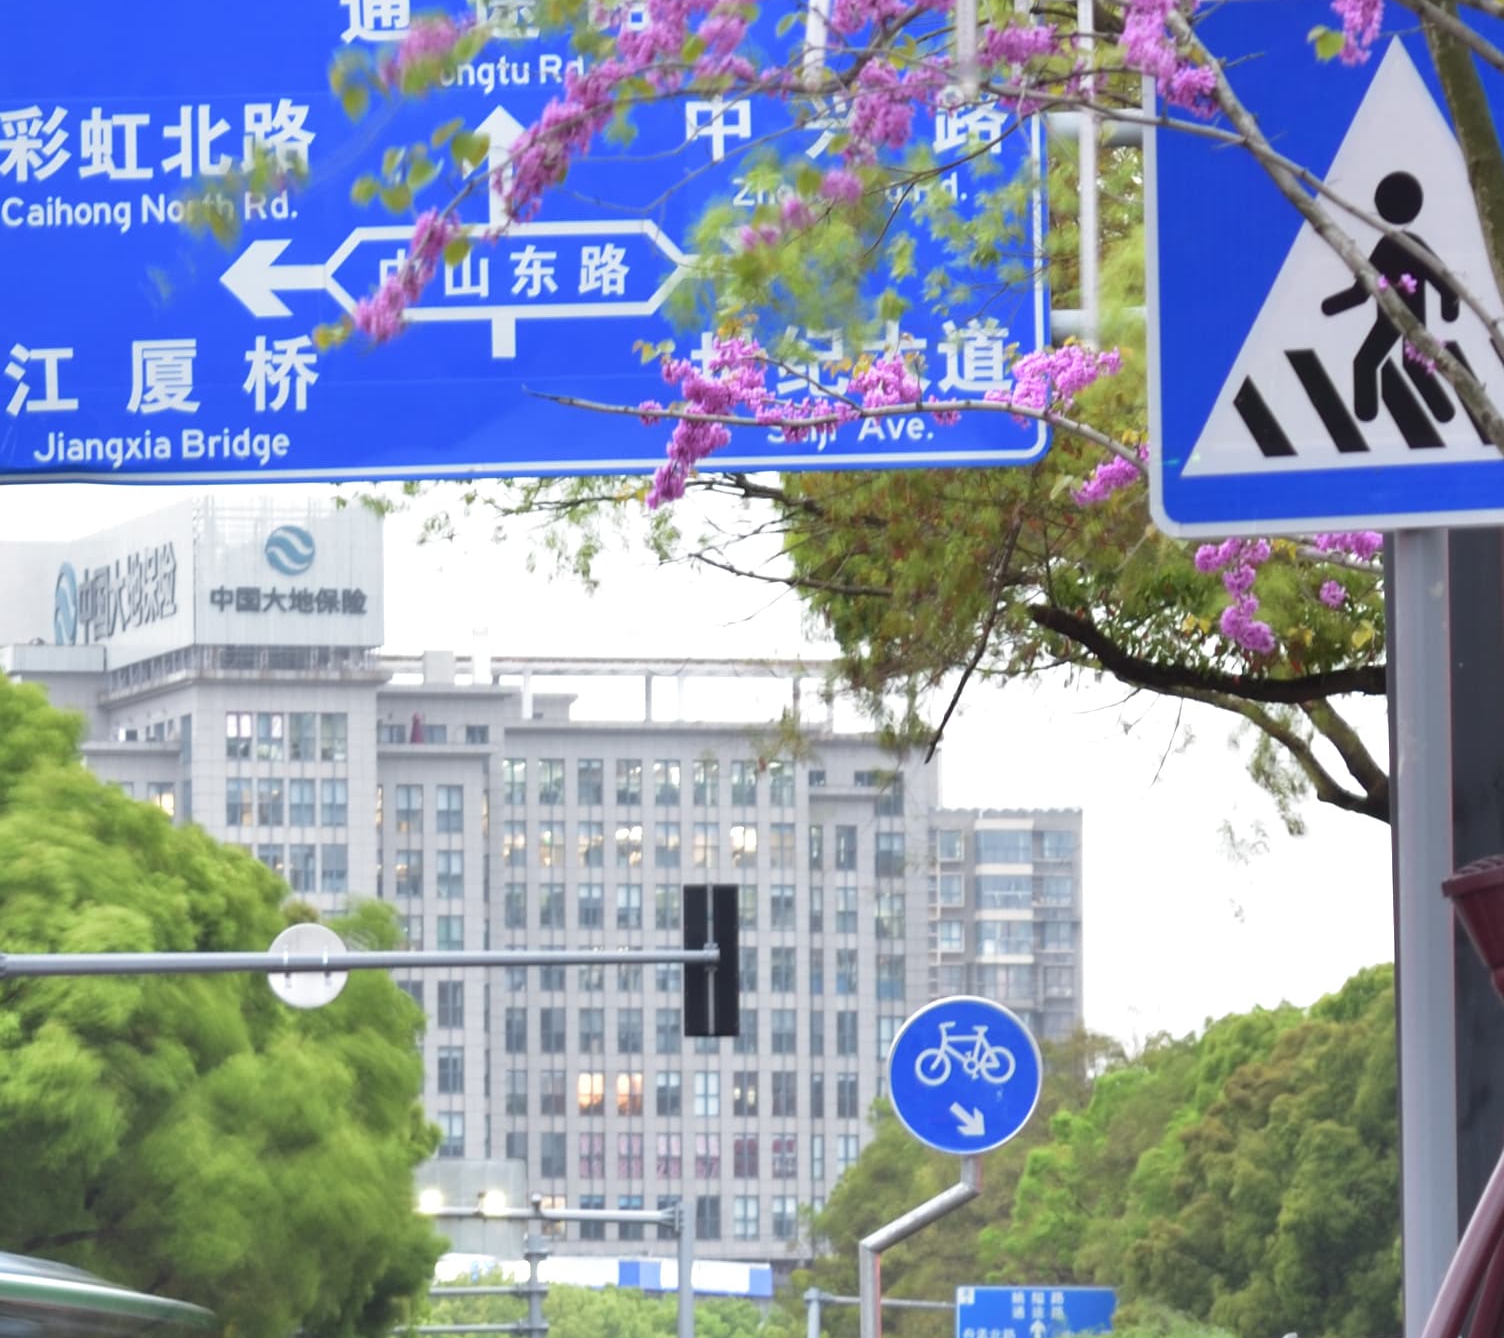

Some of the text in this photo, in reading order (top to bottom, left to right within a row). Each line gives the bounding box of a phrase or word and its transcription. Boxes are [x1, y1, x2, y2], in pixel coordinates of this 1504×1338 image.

[0, 196, 132, 234] Caihong
[244, 189, 299, 221] Rd.
[3, 335, 320, 416] 江厦桥
[33, 426, 291, 470] Jiangxia Bridge
[858, 415, 934, 441] Ave.
[208, 584, 369, 616] 中国大地保险
